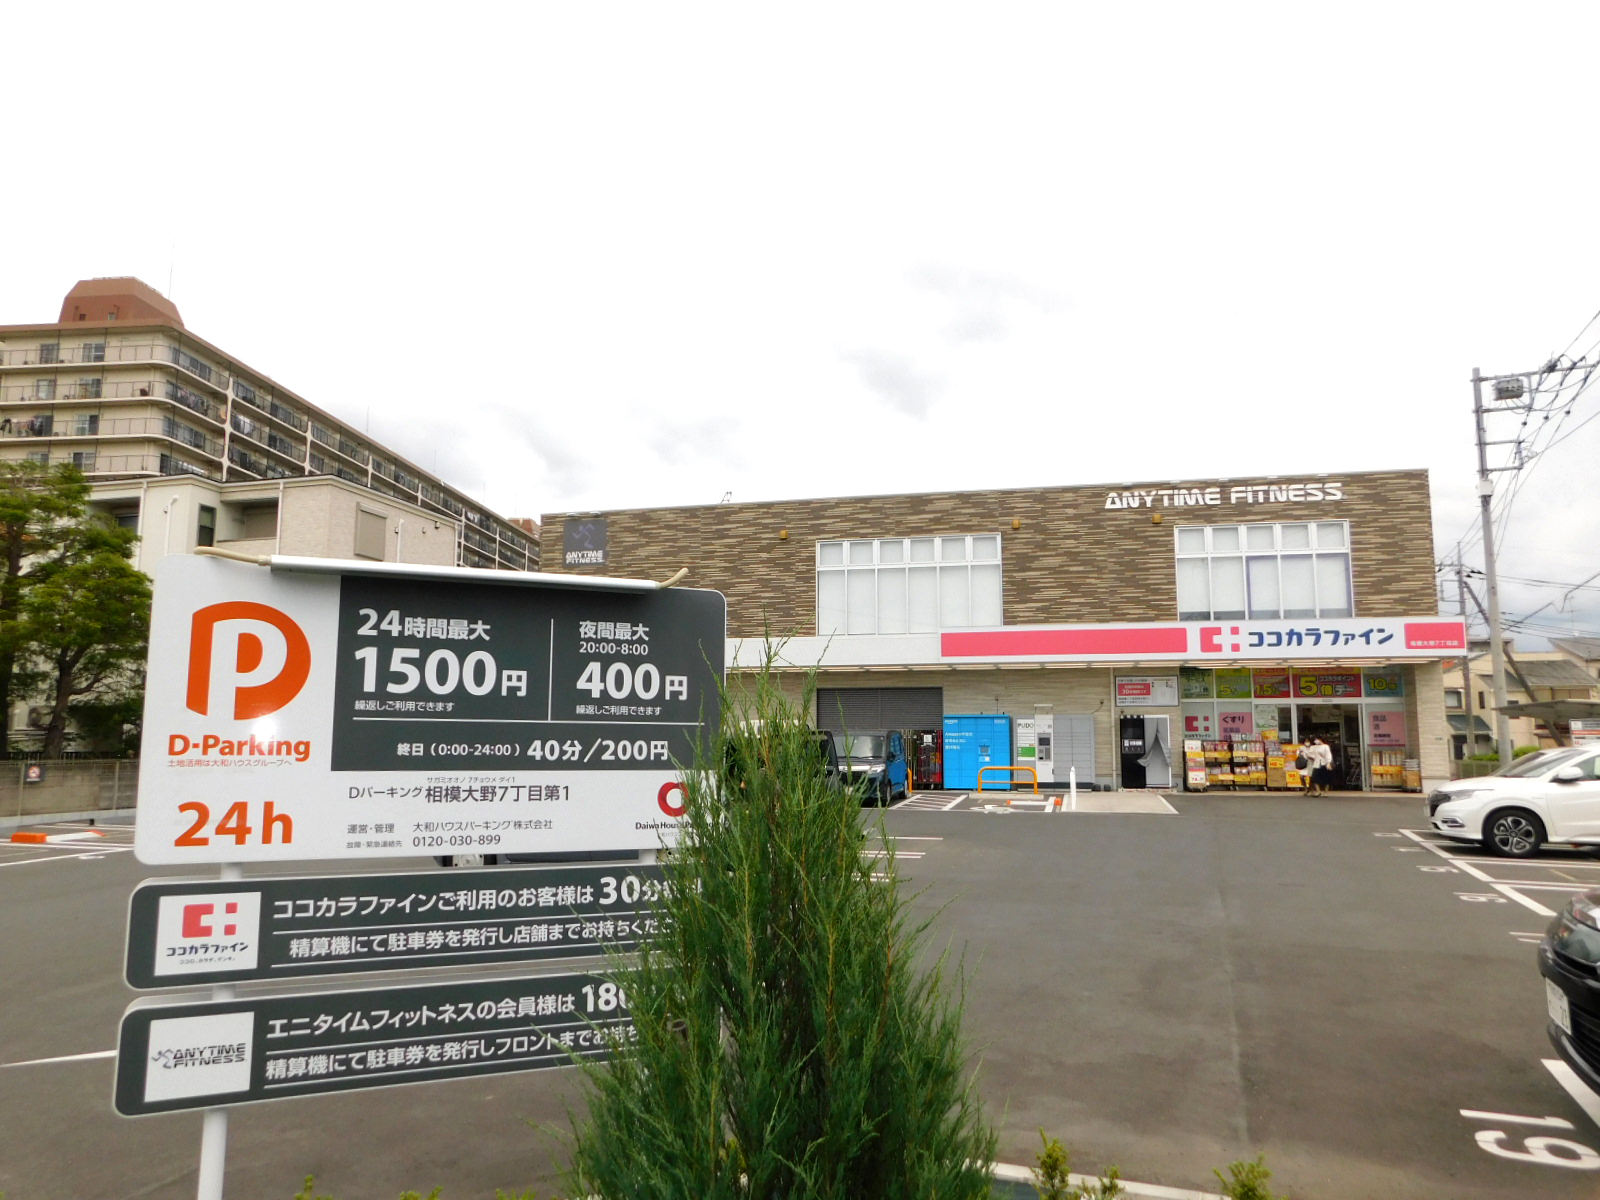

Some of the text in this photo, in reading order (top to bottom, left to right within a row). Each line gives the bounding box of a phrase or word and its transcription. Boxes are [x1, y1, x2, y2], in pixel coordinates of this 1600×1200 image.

[1104, 482, 1342, 510] ANYTIME FITNESS
[565, 550, 603, 558] ANYTIME
[356, 608, 491, 641] 24時間最大
[578, 620, 650, 641] 夜間最大
[1248, 627, 1394, 648] ココカラファイン
[578, 641, 649, 656] 20:00-8:00
[354, 646, 528, 697] 1500円
[576, 661, 688, 701] 400円
[354, 699, 455, 712] 繰返しご利用できます
[576, 704, 662, 716] 繰返しご利用できます
[1222, 715, 1245, 724] くすり
[167, 733, 311, 762] D-Parking
[174, 800, 293, 847] 24h
[635, 821, 660, 830] Daiwa
[412, 834, 502, 848] 0120-030-899
[166, 942, 249, 957] ココカラファイン
[173, 1042, 246, 1060] ANYTIME
[173, 1053, 246, 1069] FITNESS
